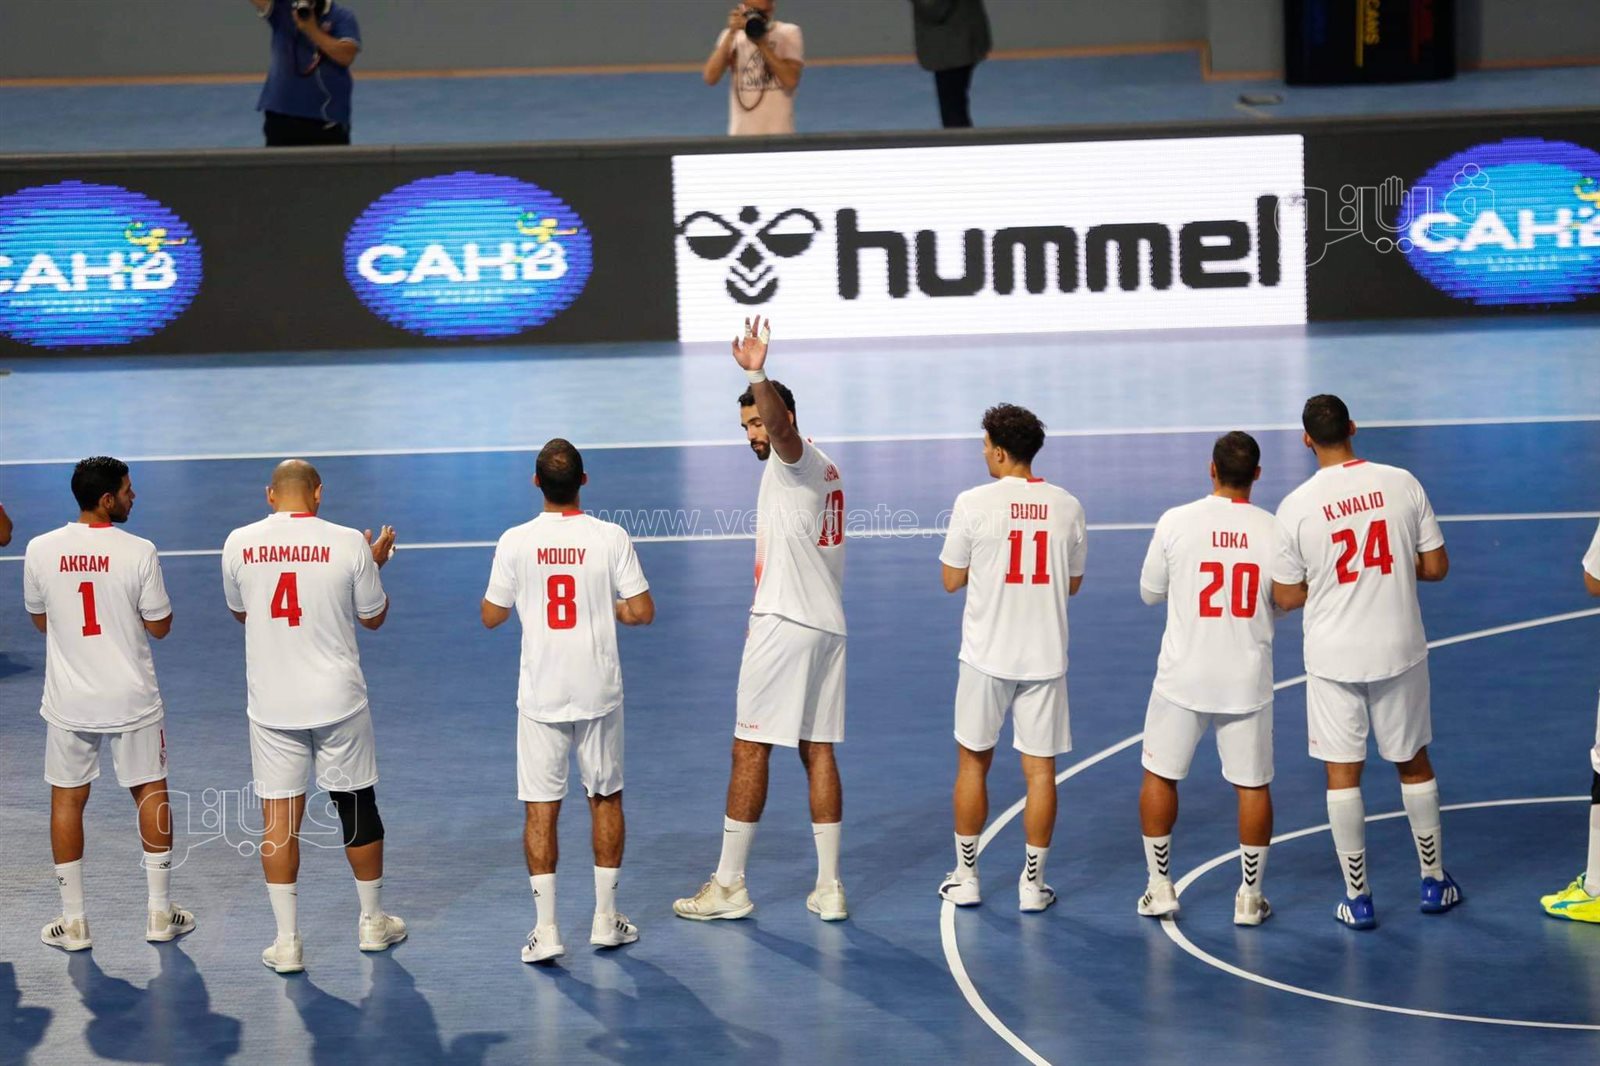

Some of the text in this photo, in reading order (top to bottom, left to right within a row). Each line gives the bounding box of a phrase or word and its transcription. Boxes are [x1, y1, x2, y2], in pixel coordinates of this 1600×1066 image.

[357, 241, 568, 285] CAHB
[836, 195, 1281, 300] hummel
[0, 252, 178, 293] AHB
[1010, 503, 1048, 520] DUDU
[1322, 491, 1384, 521] K.WALID
[242, 546, 330, 565] M.RAMADAN
[537, 548, 586, 565] MOUDY
[1005, 530, 1050, 584] 11
[1212, 531, 1248, 549] LOKA
[1331, 519, 1394, 585] 24
[59, 555, 110, 572] AKRAM
[78, 581, 102, 637] 1
[270, 572, 303, 628] 4
[547, 574, 577, 630] 8
[1199, 561, 1260, 618] 20
